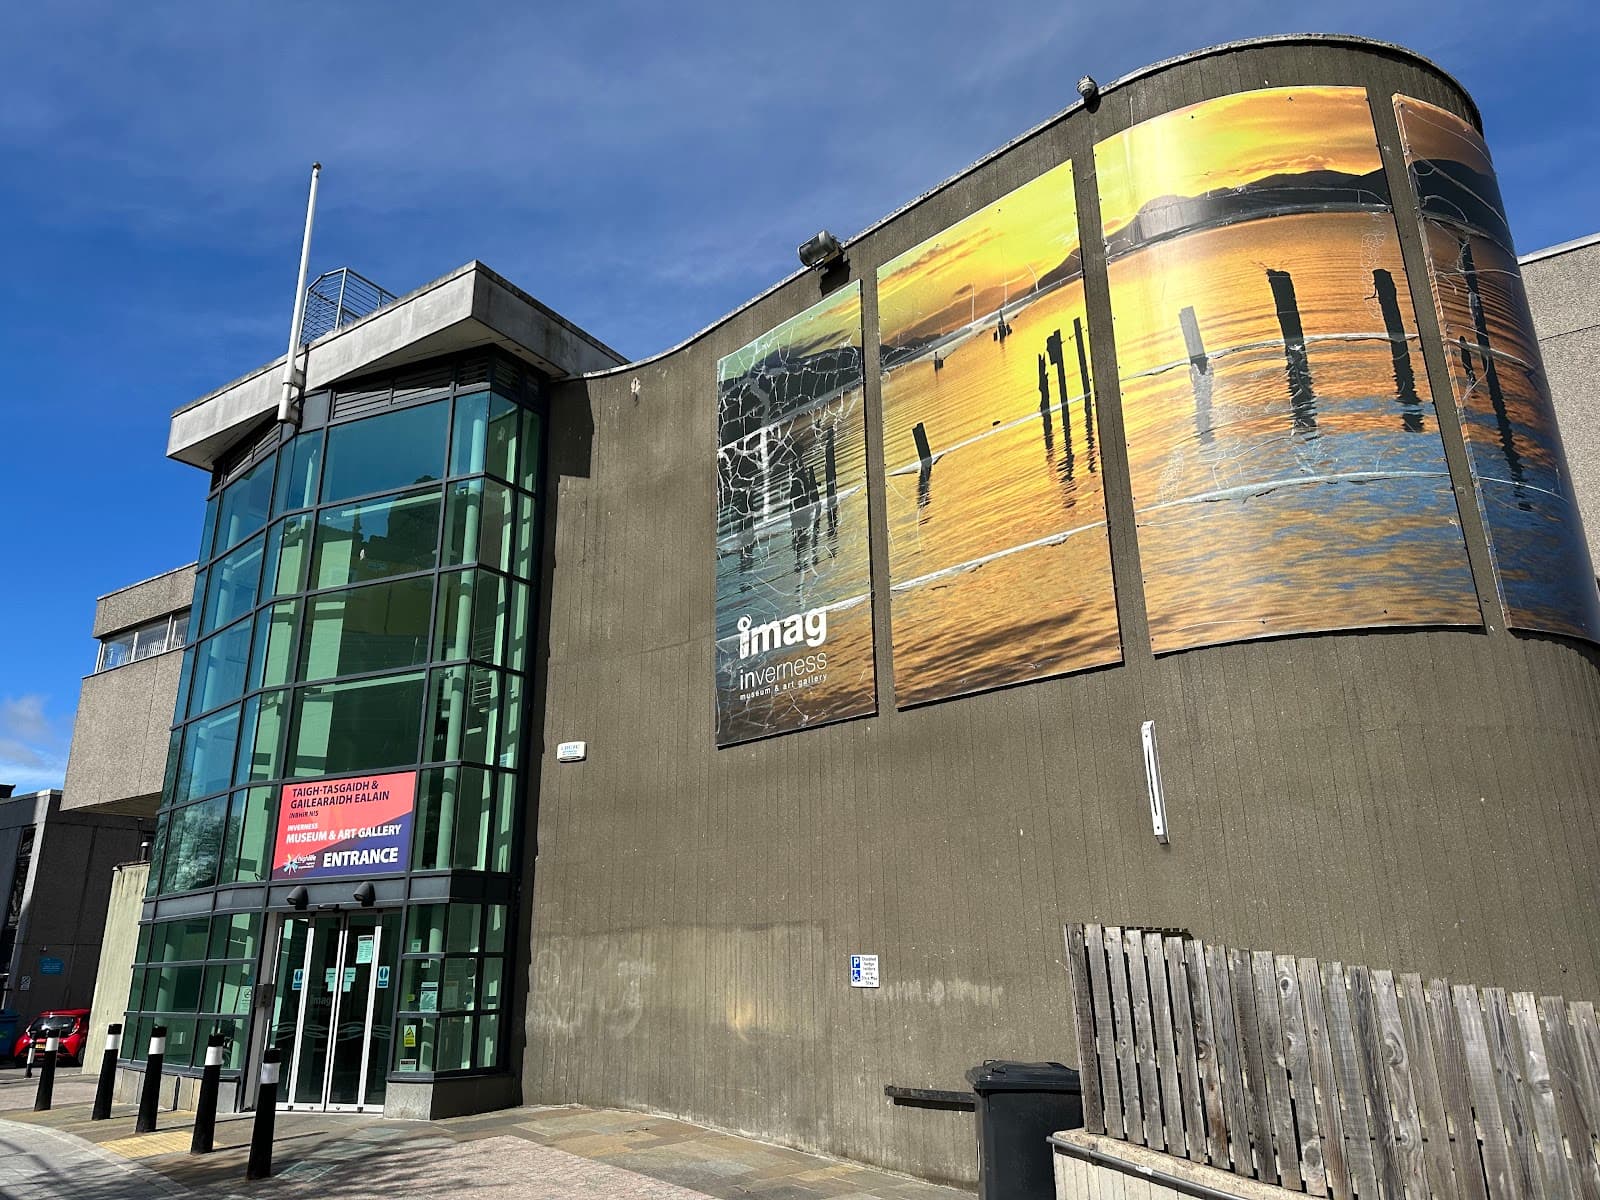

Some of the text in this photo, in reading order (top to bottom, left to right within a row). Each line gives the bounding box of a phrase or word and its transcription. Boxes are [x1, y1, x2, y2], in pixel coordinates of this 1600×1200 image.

[737, 607, 827, 660] imag
[740, 652, 827, 691] inverness
[740, 673, 828, 700] museum & art gallery
[290, 790, 390, 809] GAILEARAIDH EALAIN
[292, 780, 379, 798] TAIGH-TASGAIDH &
[286, 824, 402, 844] MUSEUM & ART GALLERY
[323, 847, 399, 868] ENTRANCE
